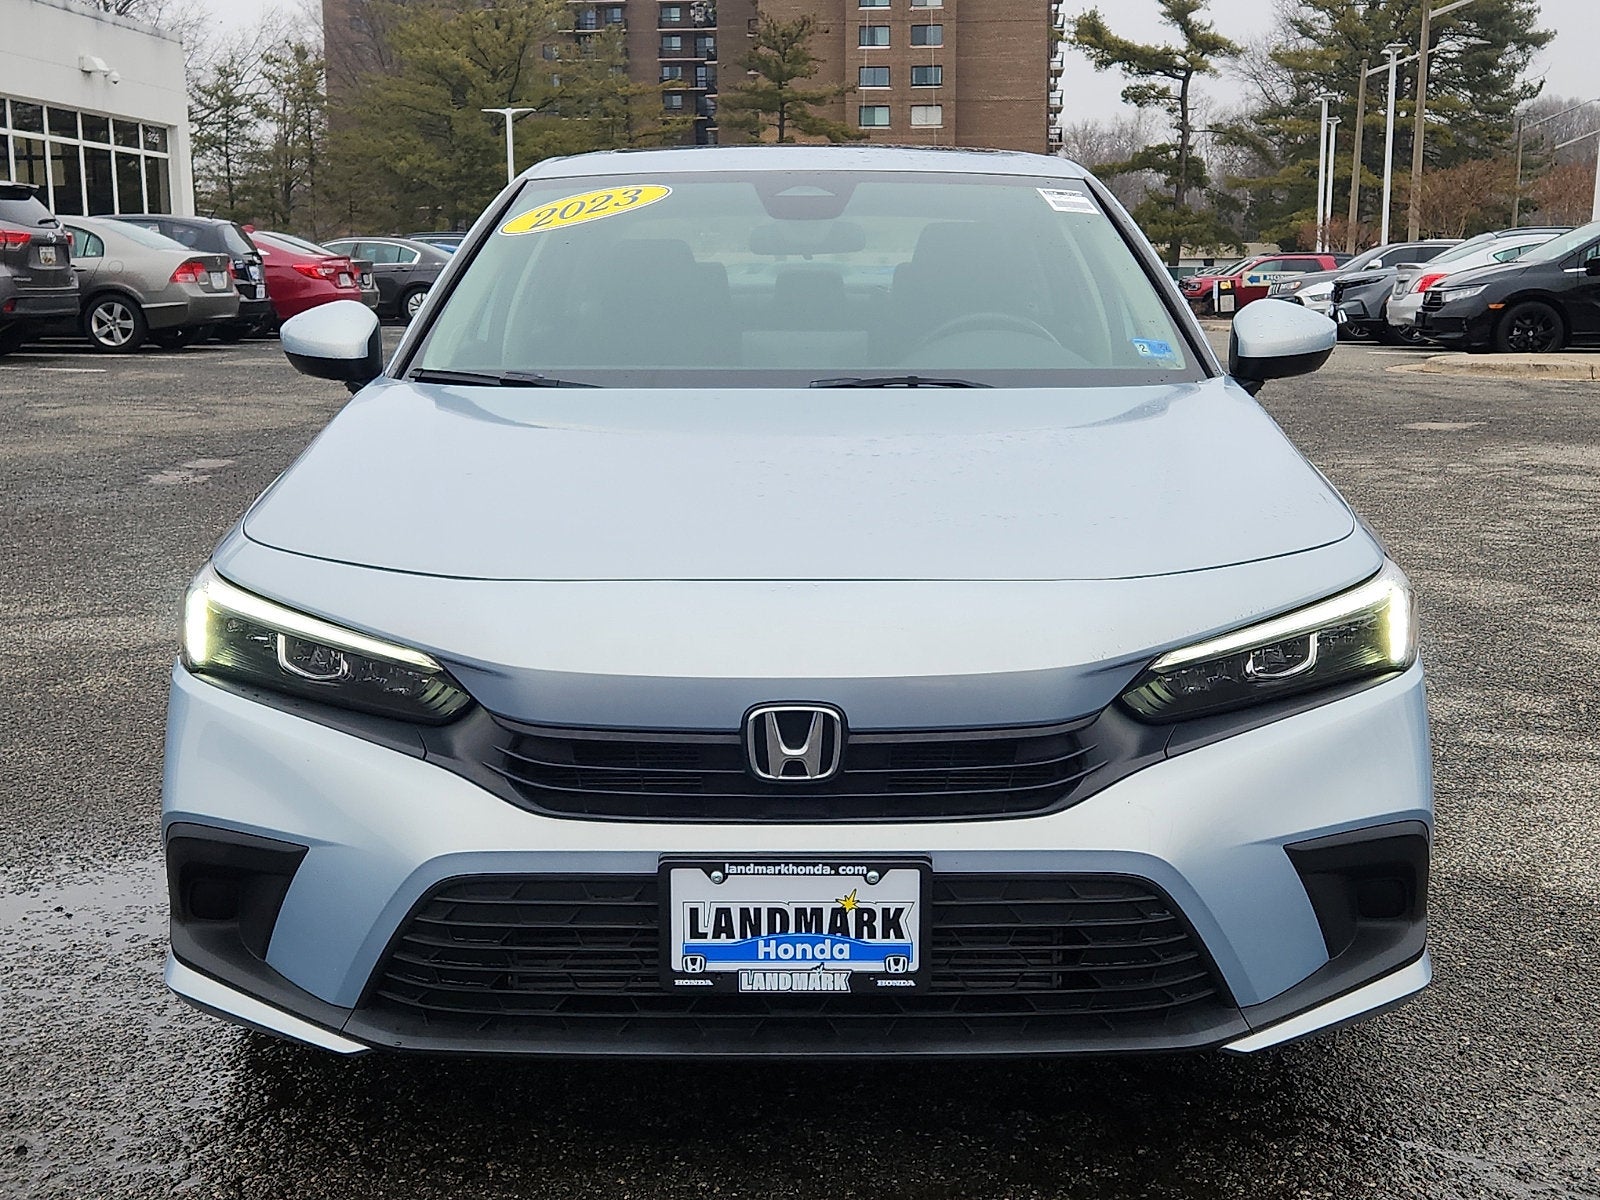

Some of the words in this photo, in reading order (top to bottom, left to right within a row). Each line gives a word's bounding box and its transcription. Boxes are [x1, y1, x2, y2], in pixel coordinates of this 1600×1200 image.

[529, 188, 643, 230] 2023
[688, 906, 905, 940] LANDMARK
[757, 939, 850, 960] Honda
[741, 971, 848, 991] LANDMARK
[876, 979, 916, 987] HONDA
